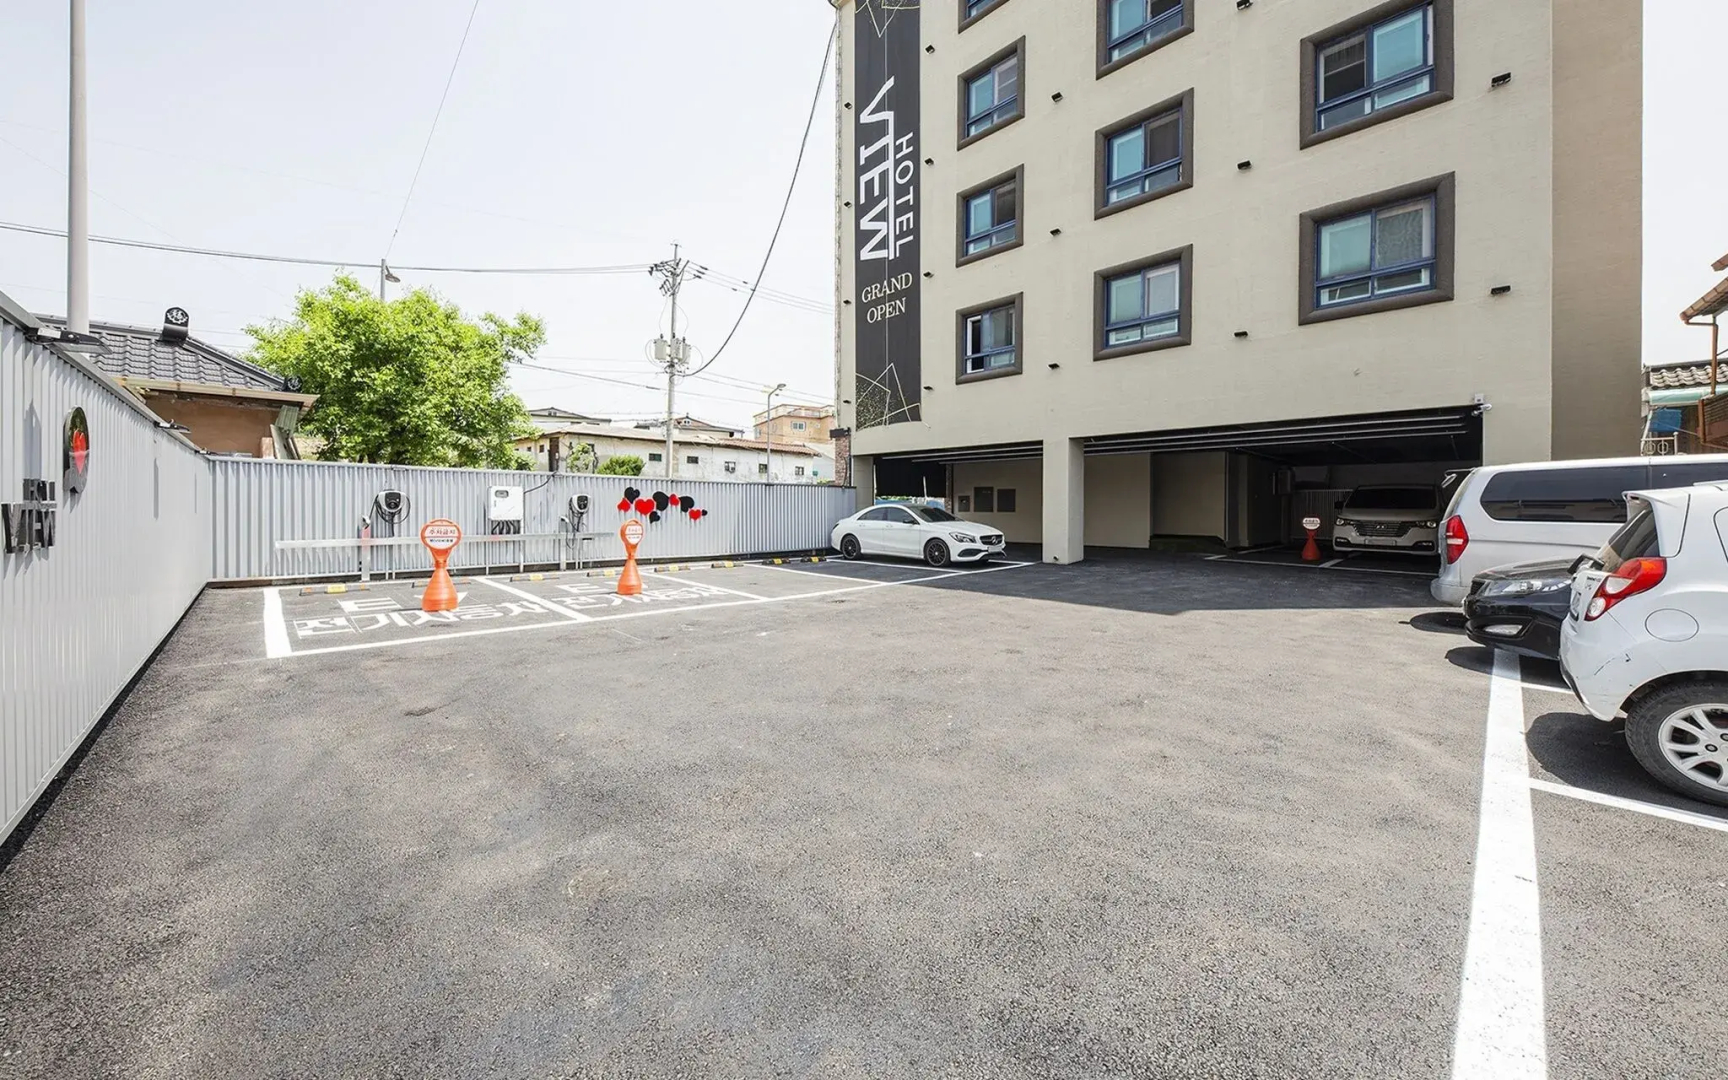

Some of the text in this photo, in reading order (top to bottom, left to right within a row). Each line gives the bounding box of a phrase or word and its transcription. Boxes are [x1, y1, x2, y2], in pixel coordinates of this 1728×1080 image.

[860, 76, 894, 260] VIEW
[896, 131, 914, 258] HOTEL
[861, 272, 913, 303] GRAND
[867, 297, 906, 324] OPEN
